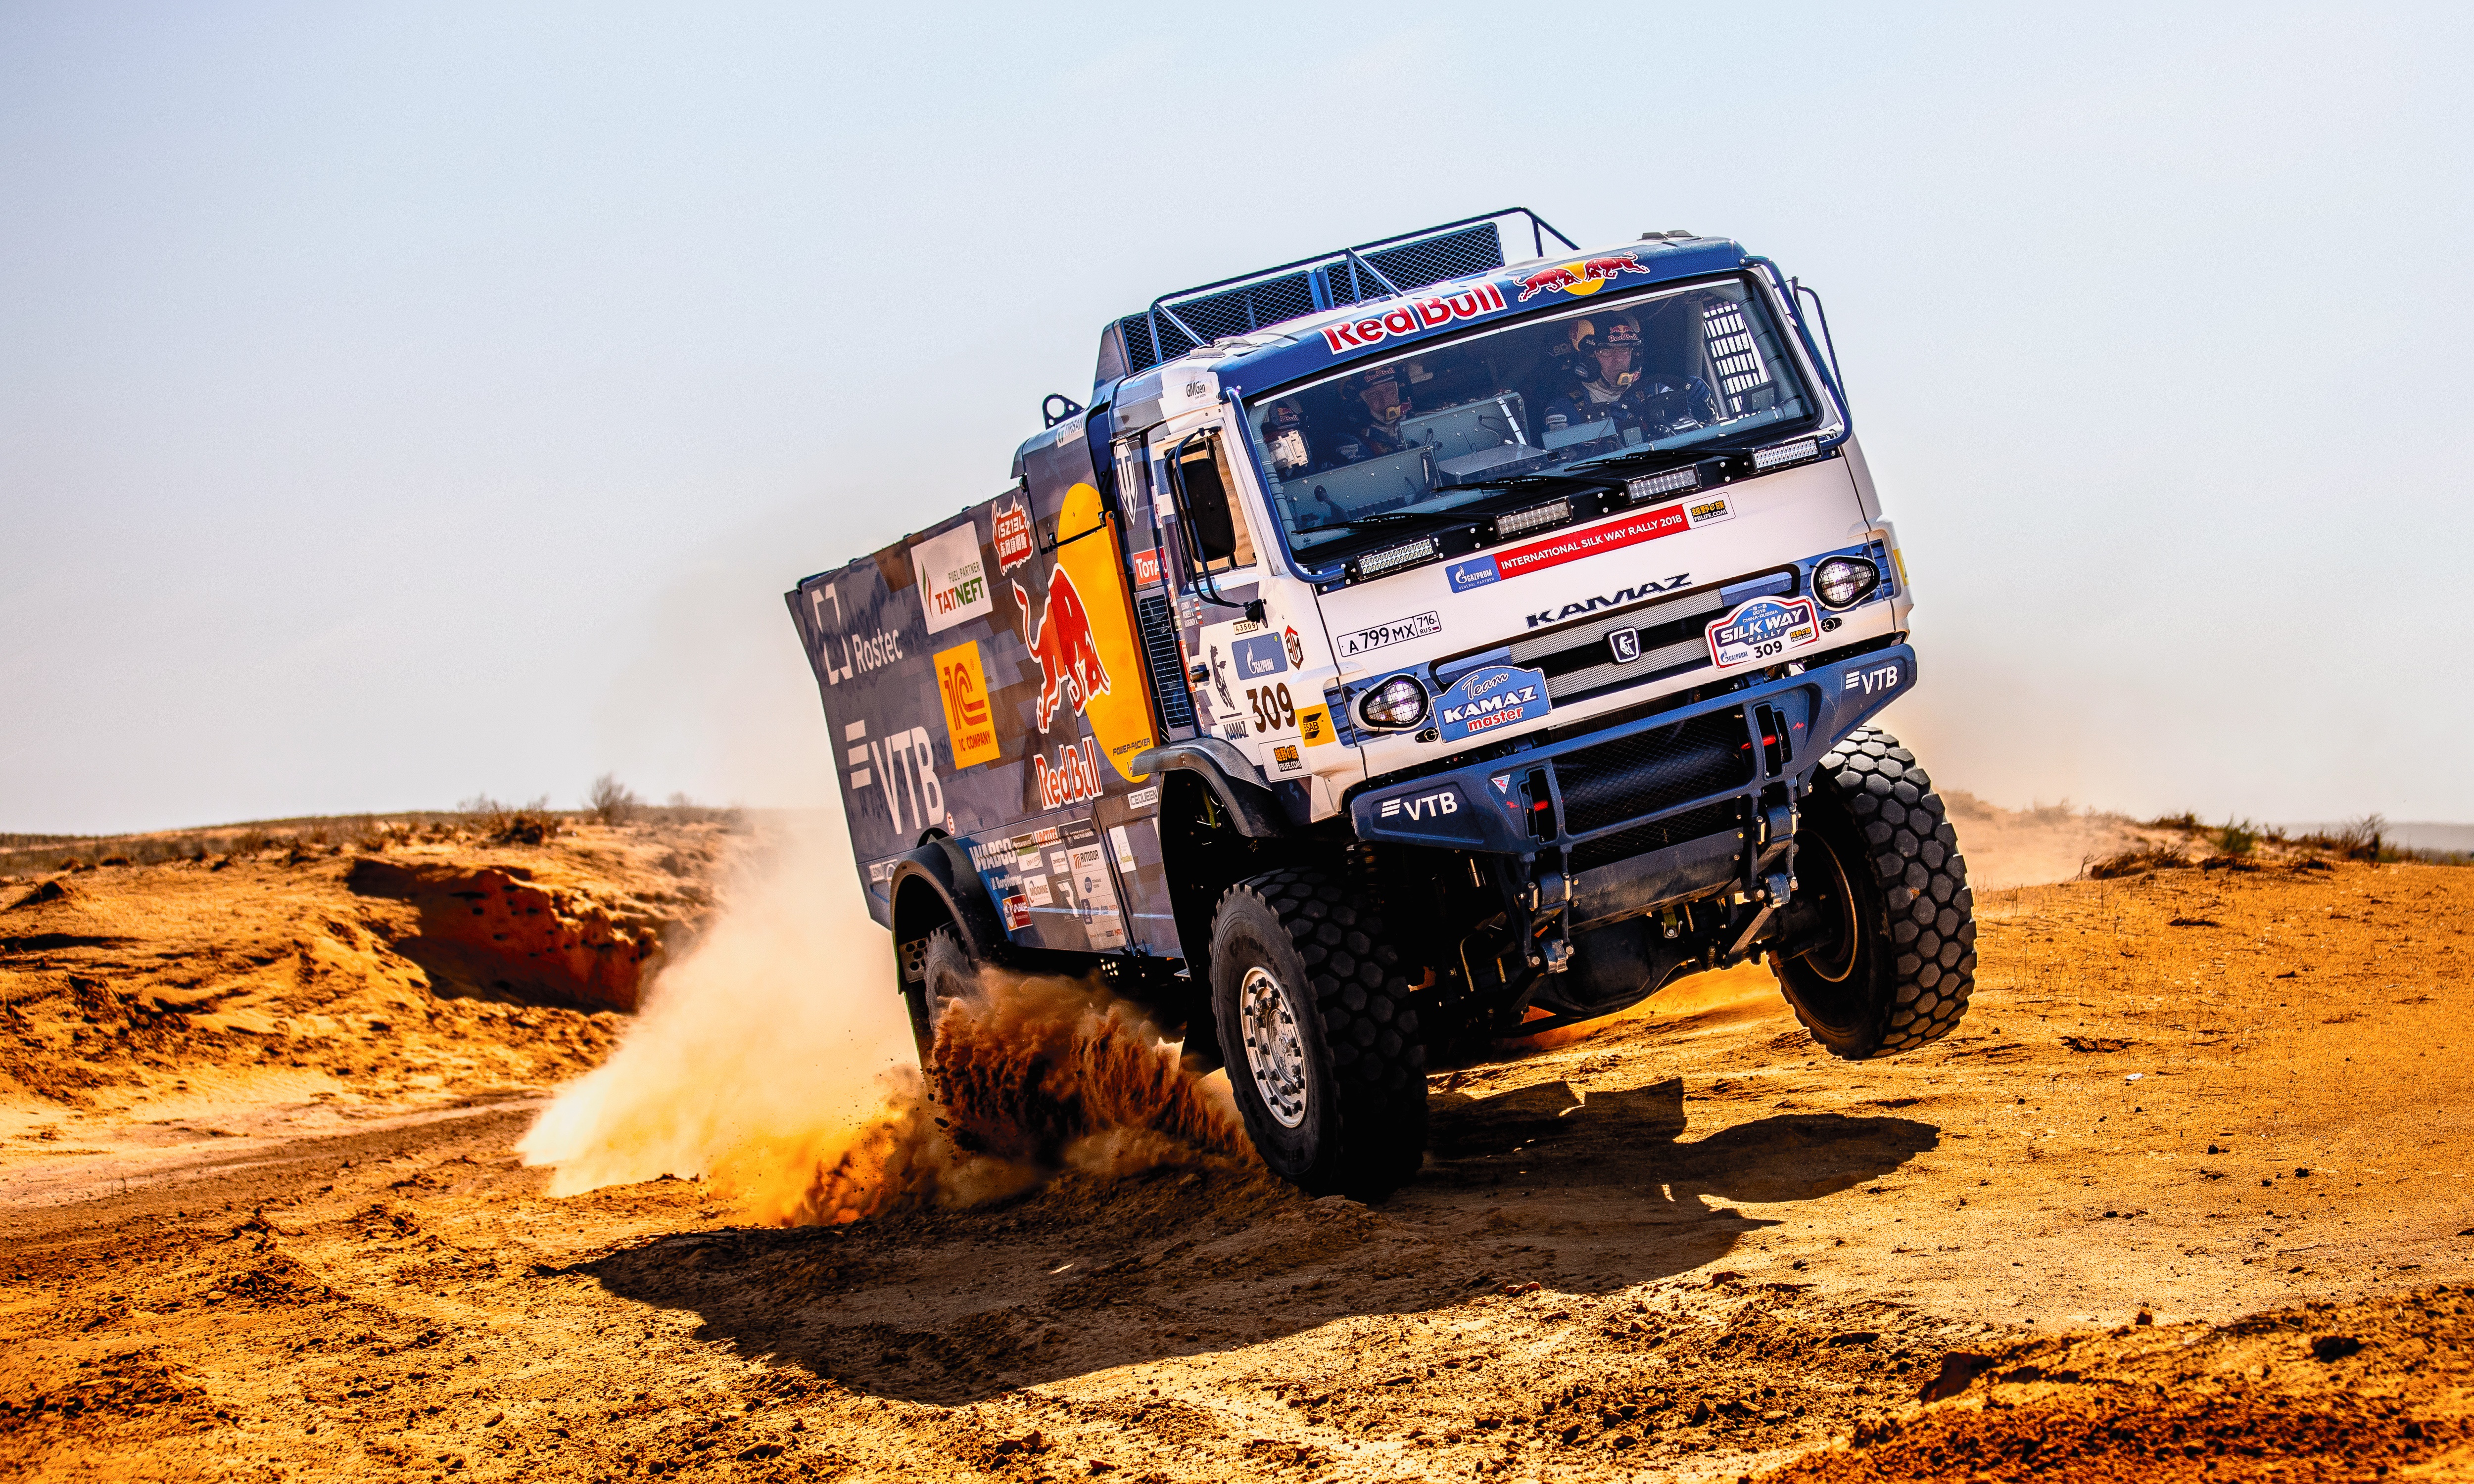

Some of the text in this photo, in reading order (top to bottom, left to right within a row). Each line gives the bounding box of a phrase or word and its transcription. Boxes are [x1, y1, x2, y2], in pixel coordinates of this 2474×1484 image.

[1323, 283, 1504, 351] Red Bull
[1694, 509, 1727, 522] FBLIFE.COM
[1501, 514, 1682, 570] INTERNATIONAL SILK WAY RALLY 2018
[948, 561, 980, 583] FUEL PARTNER
[1135, 557, 1168, 579] TOTAL
[1467, 568, 1493, 582] GAZPROM
[1458, 577, 1495, 590] GENERAL PARTNER
[935, 576, 984, 615] TATNEFT
[1526, 572, 1693, 629] KAMAZ
[1720, 608, 1804, 644] SILK WAY
[1742, 610, 1779, 623] CHINA-RUSSIA
[1236, 623, 1256, 632] 43509
[1349, 614, 1435, 653] A 799 MX 716
[1748, 629, 1782, 643] RALLY
[1791, 633, 1812, 643] FBLIFE.COM
[851, 628, 903, 674] Rostec
[1728, 651, 1748, 661] GAZPROM
[1754, 640, 1782, 659] 309
[1255, 658, 1275, 673] GAZPROM
[1462, 672, 1509, 700] Team
[1860, 665, 1898, 695] VTB
[1246, 682, 1296, 733] 309
[1443, 685, 1538, 724] KAMAZ
[1304, 721, 1319, 732] ESAB
[1467, 706, 1524, 733] master
[966, 730, 991, 750] COMPANY
[1223, 721, 1249, 741] KAMAZ
[1113, 737, 1150, 757] POWER-PACKER
[1034, 739, 1102, 807] Red Bull
[1278, 760, 1301, 771] FBLIFE.COM
[871, 726, 945, 835] VTB
[1130, 789, 1158, 806] ICEQUEEN
[1403, 791, 1458, 821] VTB
[1036, 828, 1060, 846] LOCTITE
[969, 837, 1017, 873] WABCO
[1080, 849, 1099, 863] AVTODOR
[1029, 884, 1049, 896] MODINE
